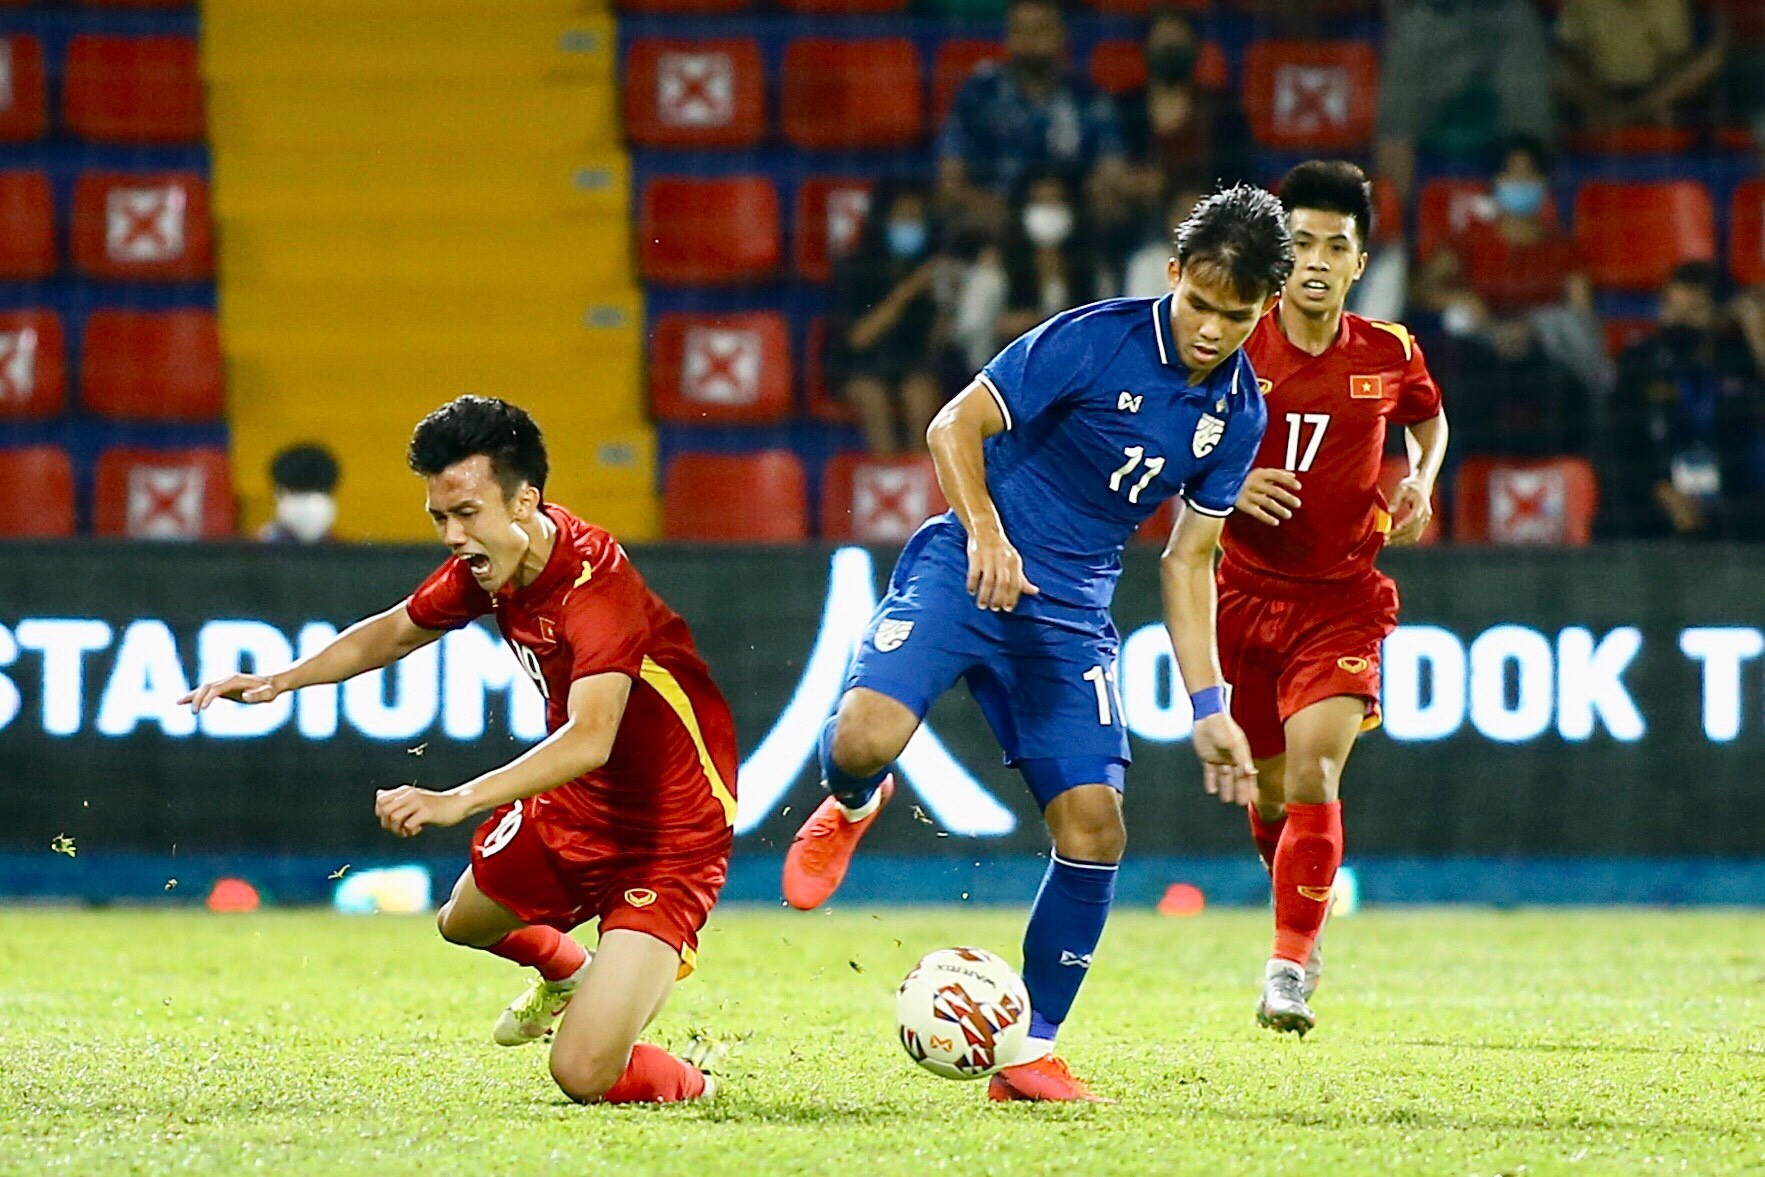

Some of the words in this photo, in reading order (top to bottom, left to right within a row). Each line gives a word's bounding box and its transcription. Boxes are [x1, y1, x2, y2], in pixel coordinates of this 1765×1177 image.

[1285, 412, 1331, 472] 17
[1108, 445, 1167, 505] 11
[1678, 627, 1765, 742] T
